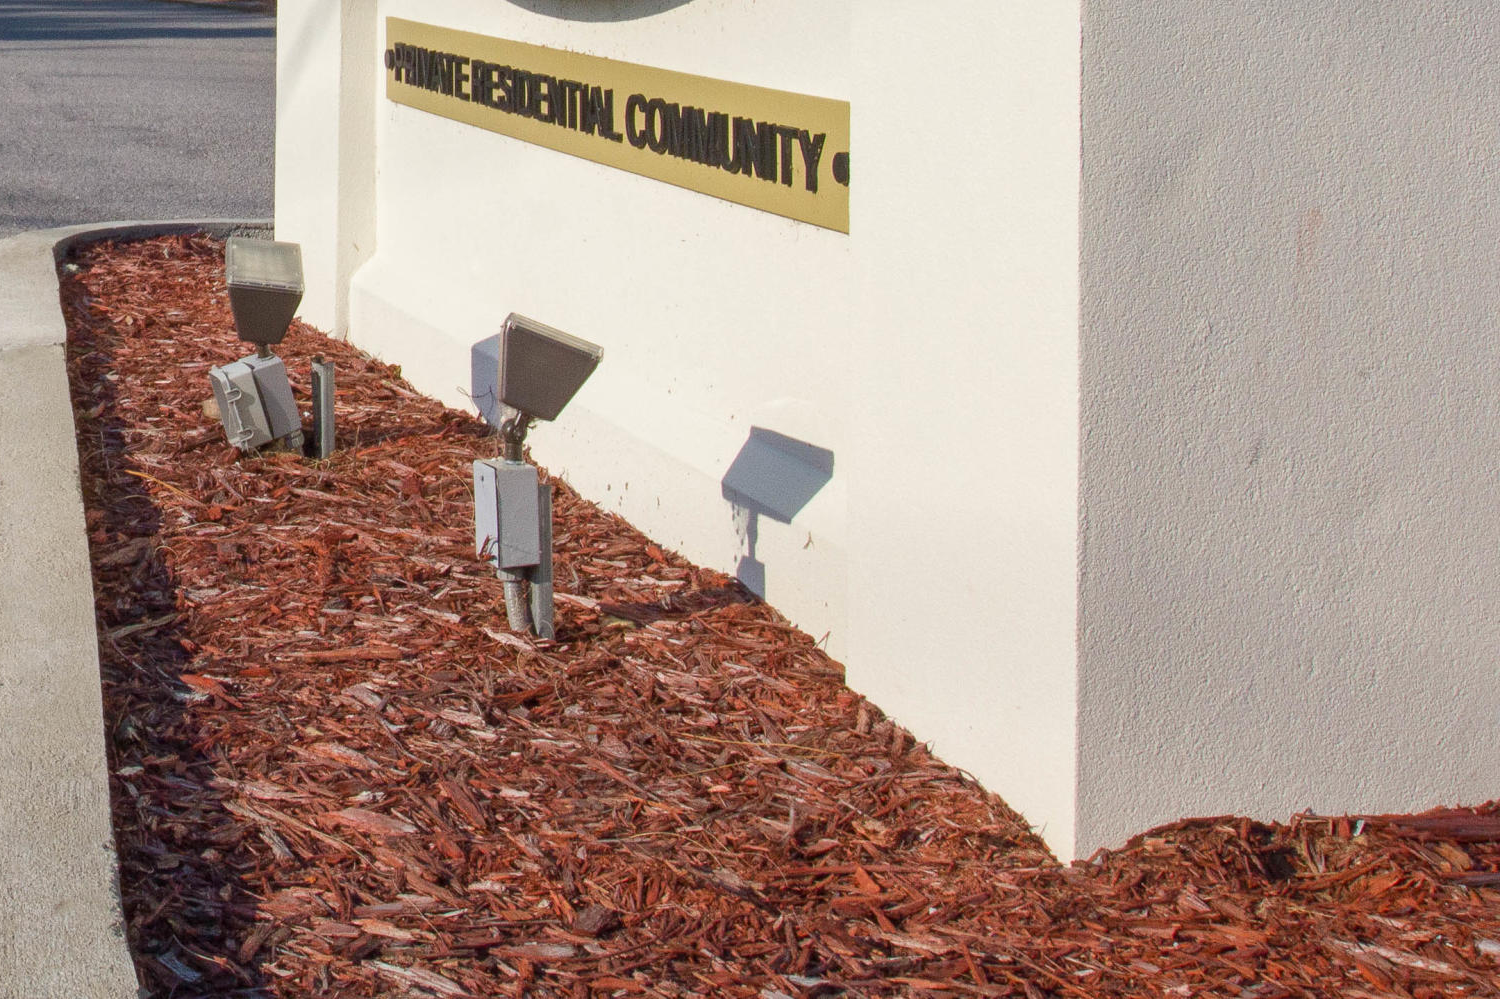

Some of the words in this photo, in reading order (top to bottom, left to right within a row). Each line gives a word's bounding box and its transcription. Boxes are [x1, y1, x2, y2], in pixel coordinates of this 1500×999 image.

[393, 41, 470, 102] PRIVATE
[471, 59, 623, 143] RESIDENTIAL
[624, 93, 827, 194] COMMUNITY
